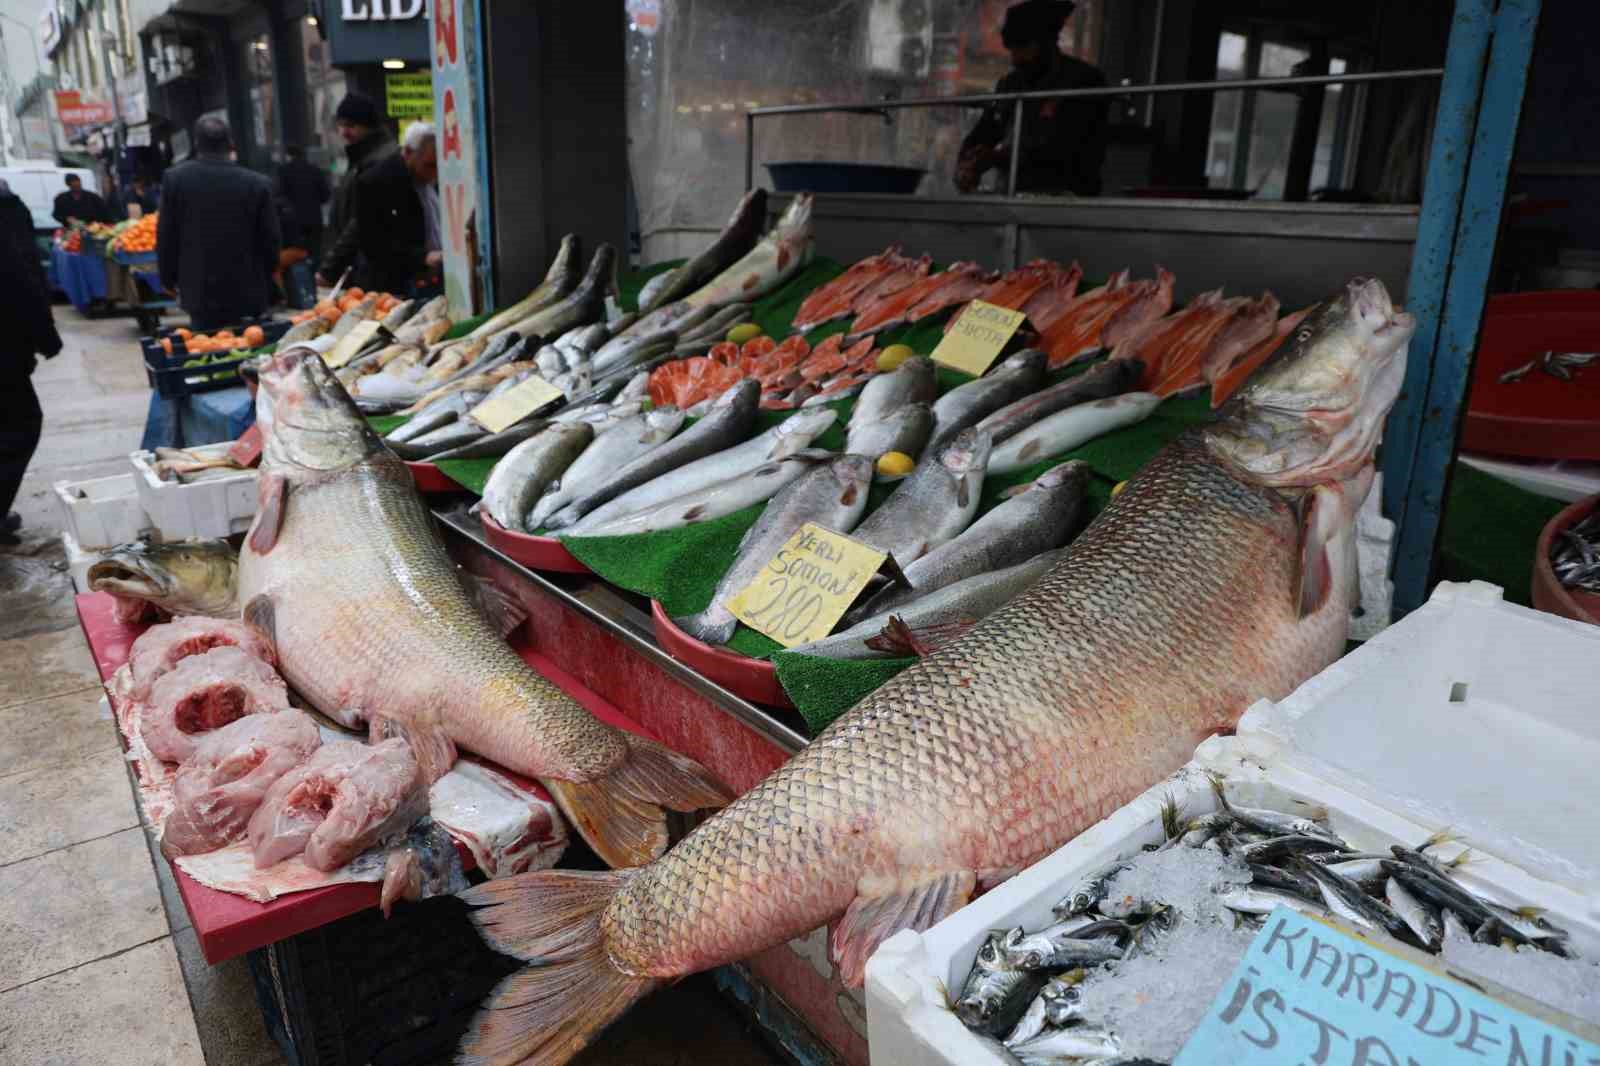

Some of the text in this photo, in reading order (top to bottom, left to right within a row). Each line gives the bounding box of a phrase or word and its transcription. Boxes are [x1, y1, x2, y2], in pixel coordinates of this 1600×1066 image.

[744, 577, 823, 639] 280
[1219, 966, 1422, 1066] İSTA
[1262, 918, 1600, 1066] KARADENİ
